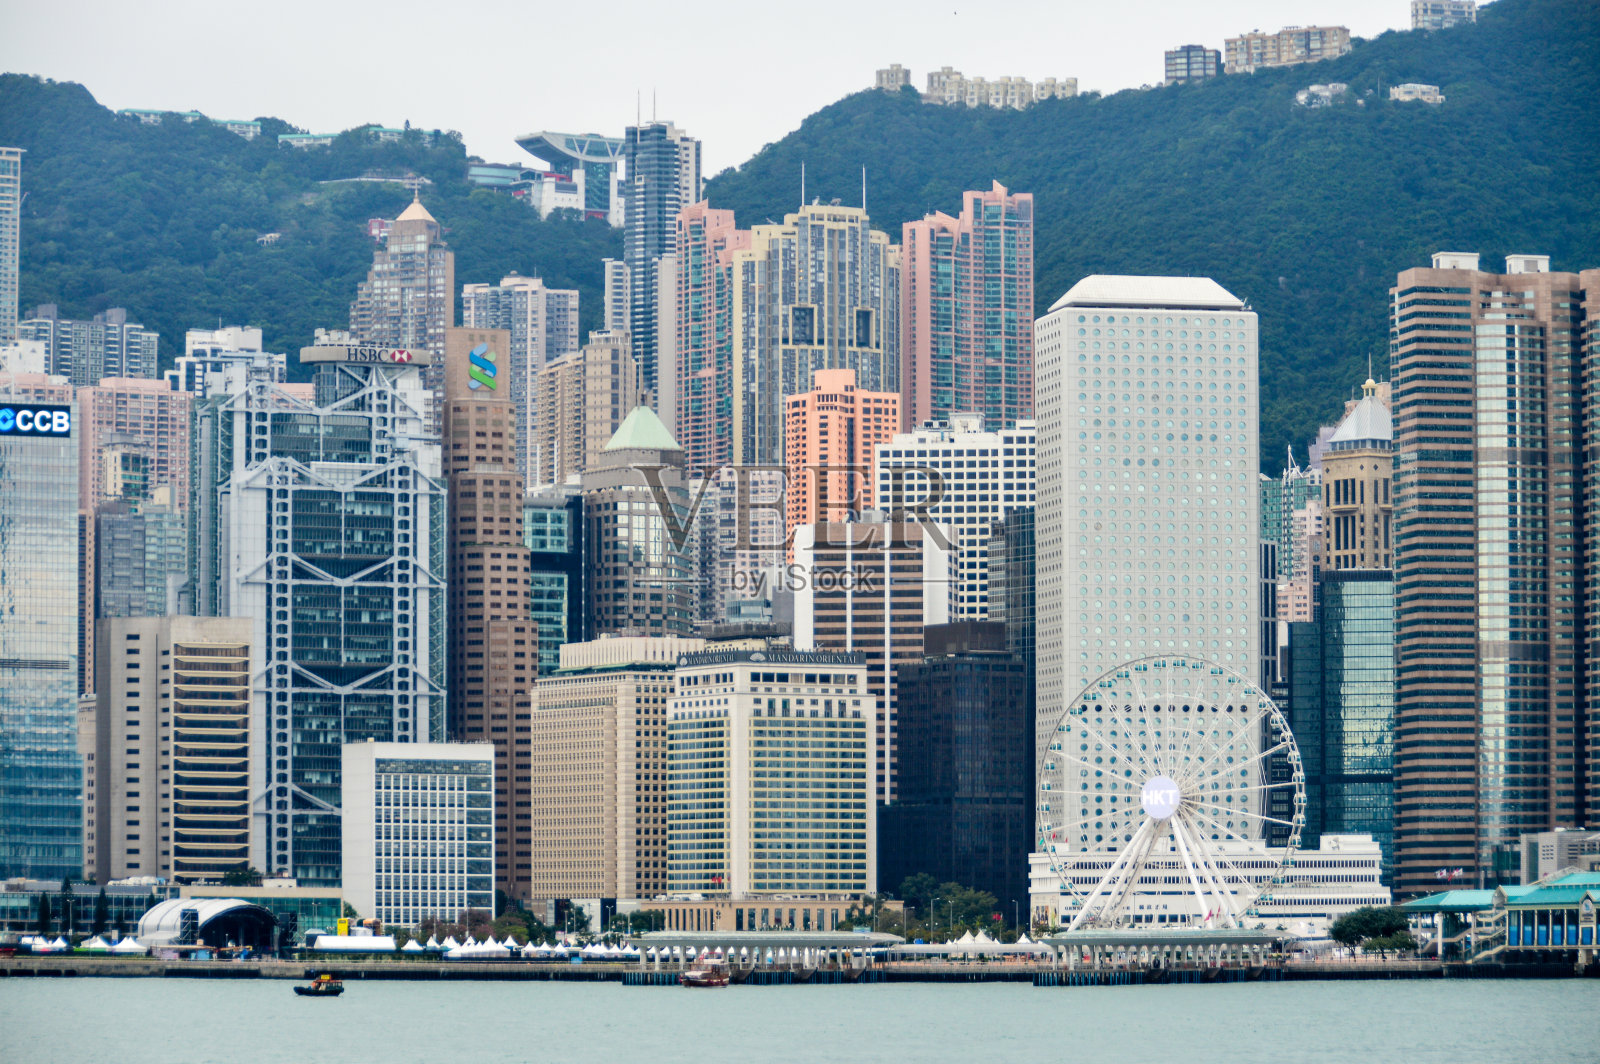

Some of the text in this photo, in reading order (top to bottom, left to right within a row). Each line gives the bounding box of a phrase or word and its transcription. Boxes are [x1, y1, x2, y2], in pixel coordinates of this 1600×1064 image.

[347, 348, 389, 361] HSBC
[16, 409, 70, 433] CCB
[768, 653, 856, 664] MANDARIN ORIENTAL
[1142, 789, 1177, 805] HKT
